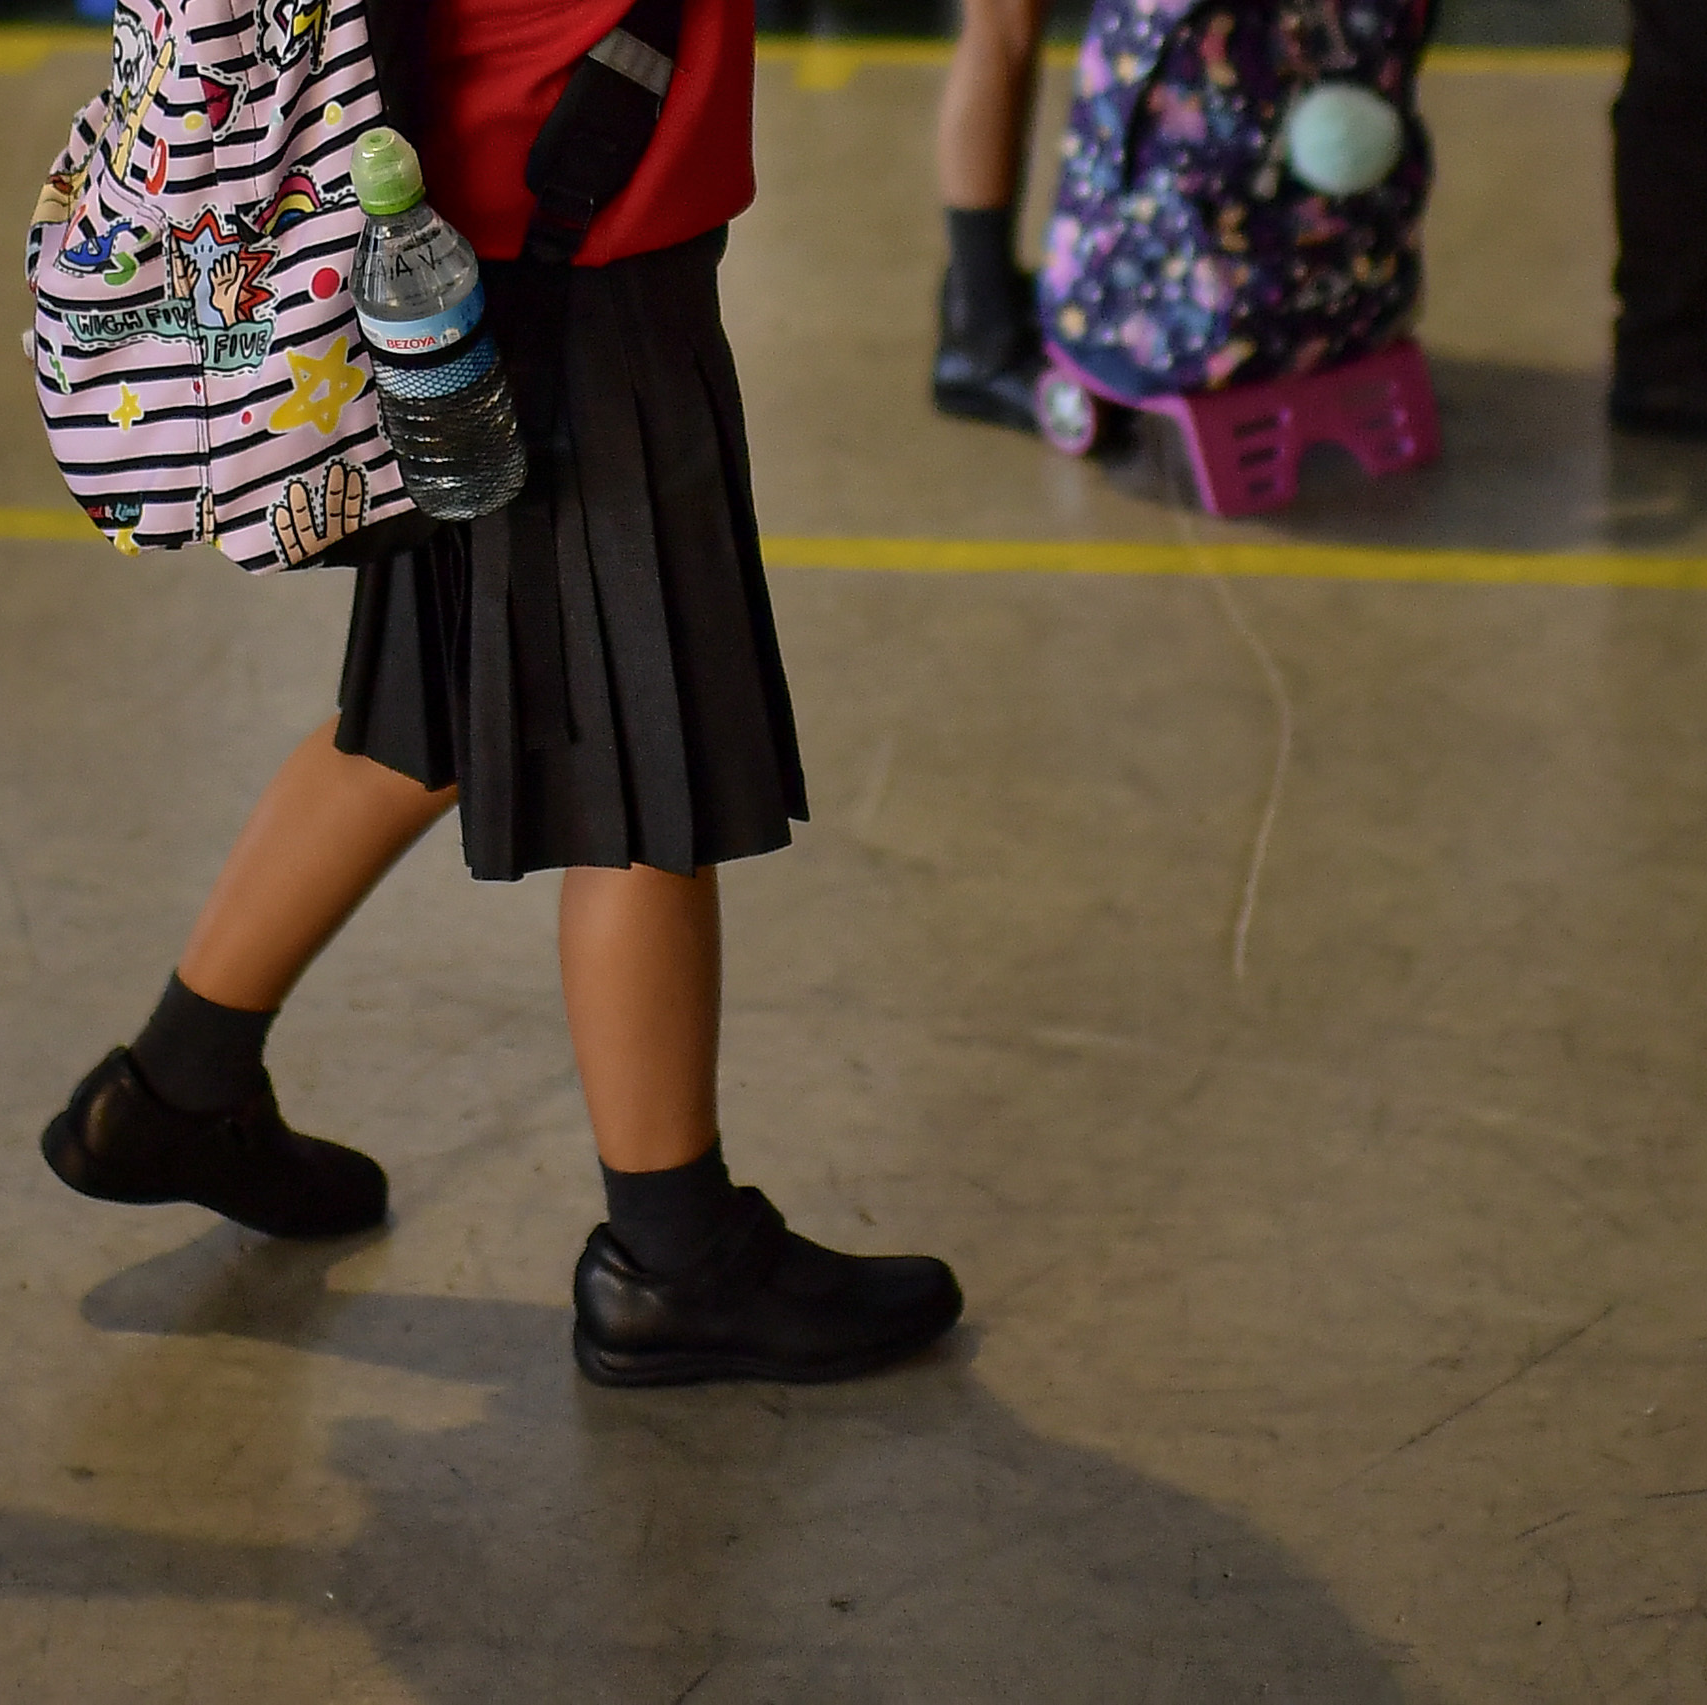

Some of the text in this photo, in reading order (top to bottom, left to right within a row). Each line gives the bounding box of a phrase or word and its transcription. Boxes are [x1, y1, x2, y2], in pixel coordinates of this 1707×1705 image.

[77, 305, 195, 337] HIGH FIV
[214, 330, 269, 364] FIVE
[386, 335, 438, 350] BEZOYA
